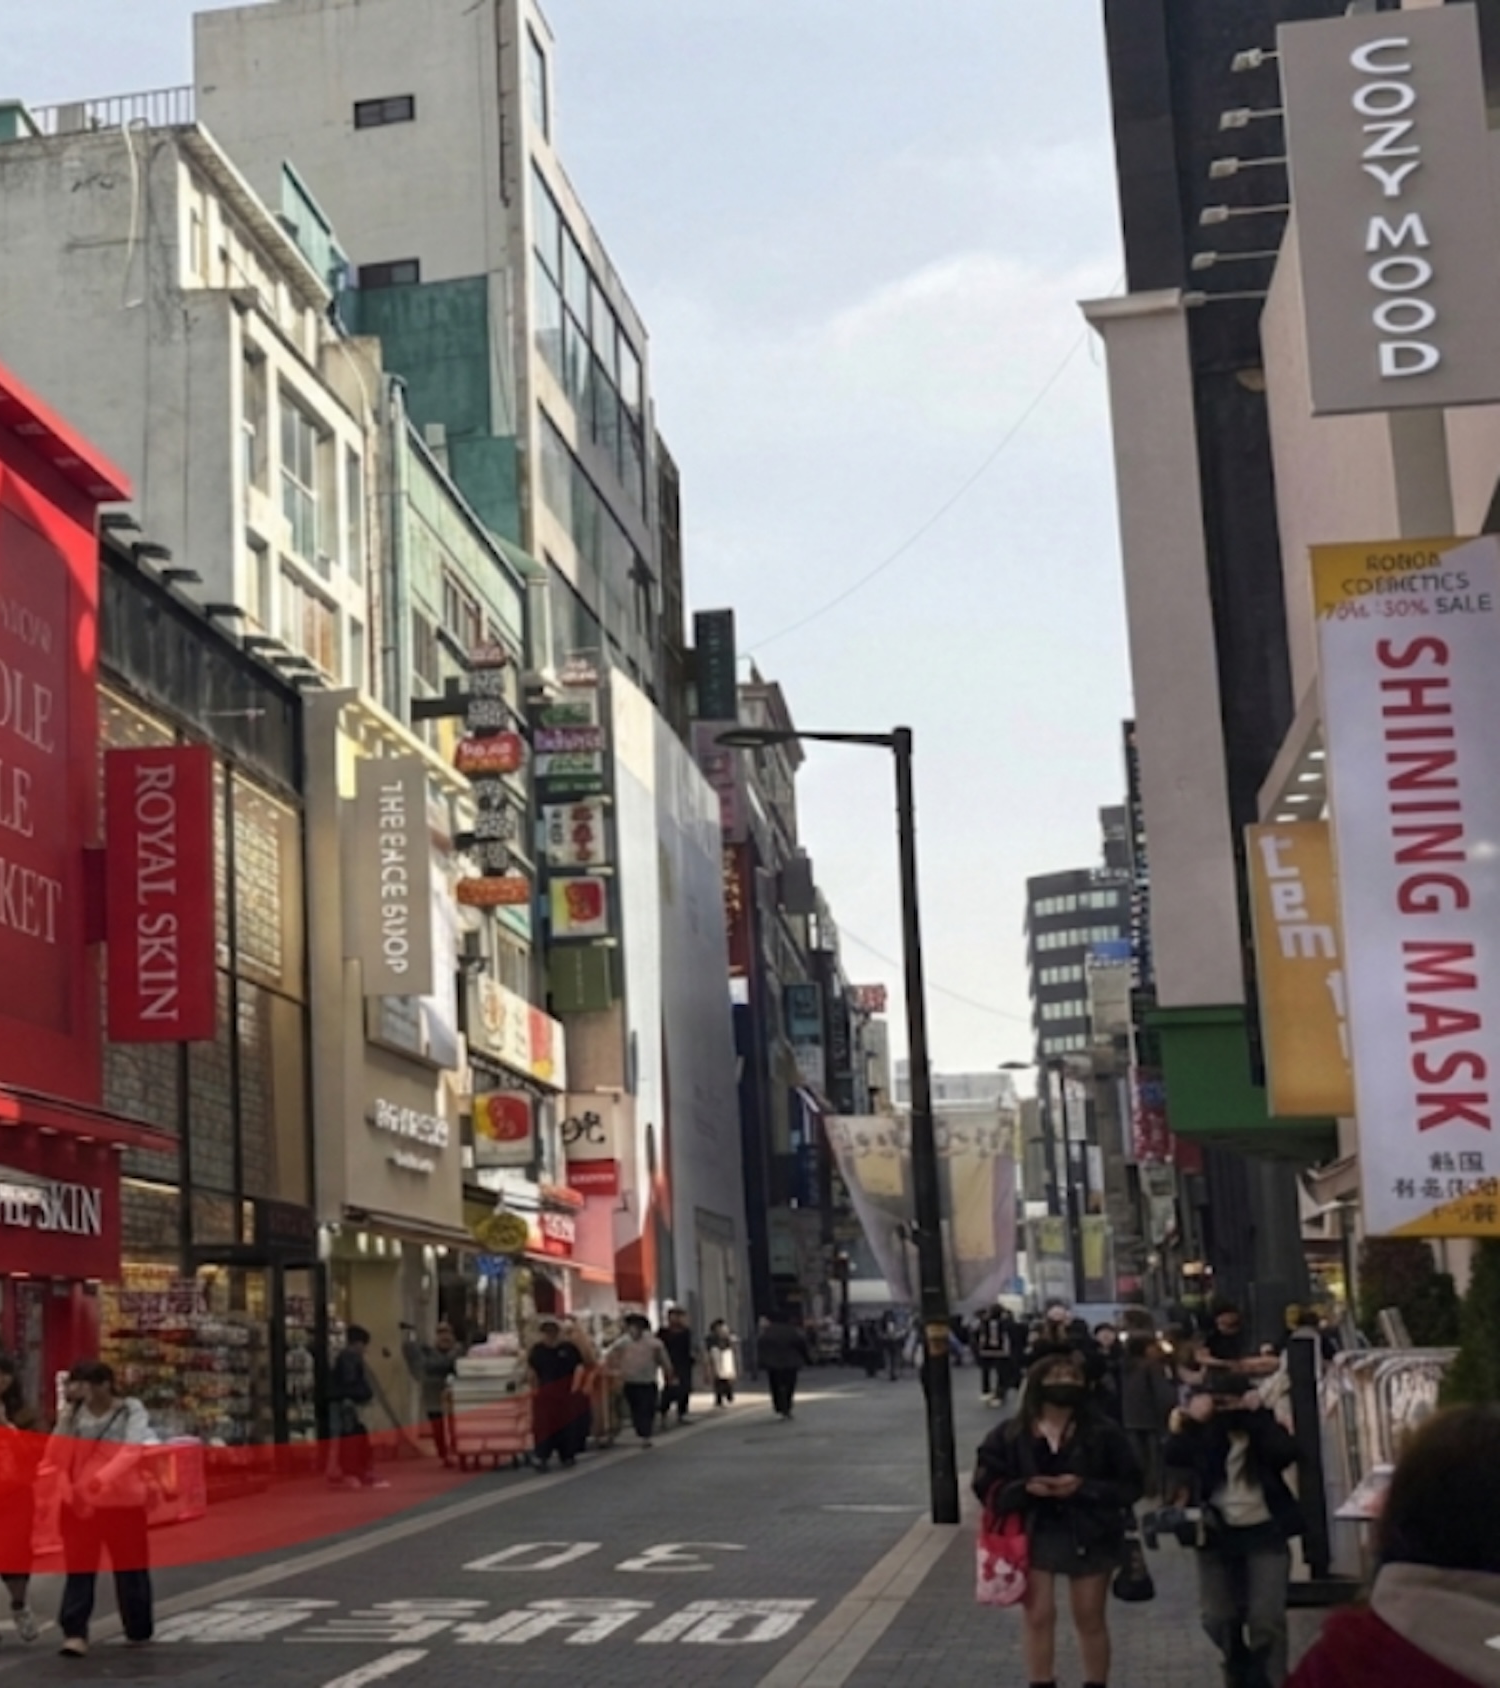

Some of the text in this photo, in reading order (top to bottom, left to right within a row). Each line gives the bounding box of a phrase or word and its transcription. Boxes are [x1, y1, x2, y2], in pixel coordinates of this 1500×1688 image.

[1350, 38, 1440, 377] COZY MOOD
[1436, 593, 1492, 614] SALE
[379, 780, 405, 828] THE
[1376, 636, 1470, 914] SHINING
[135, 764, 179, 1021] ROYAL SKIN
[1402, 942, 1491, 1132] MASK
